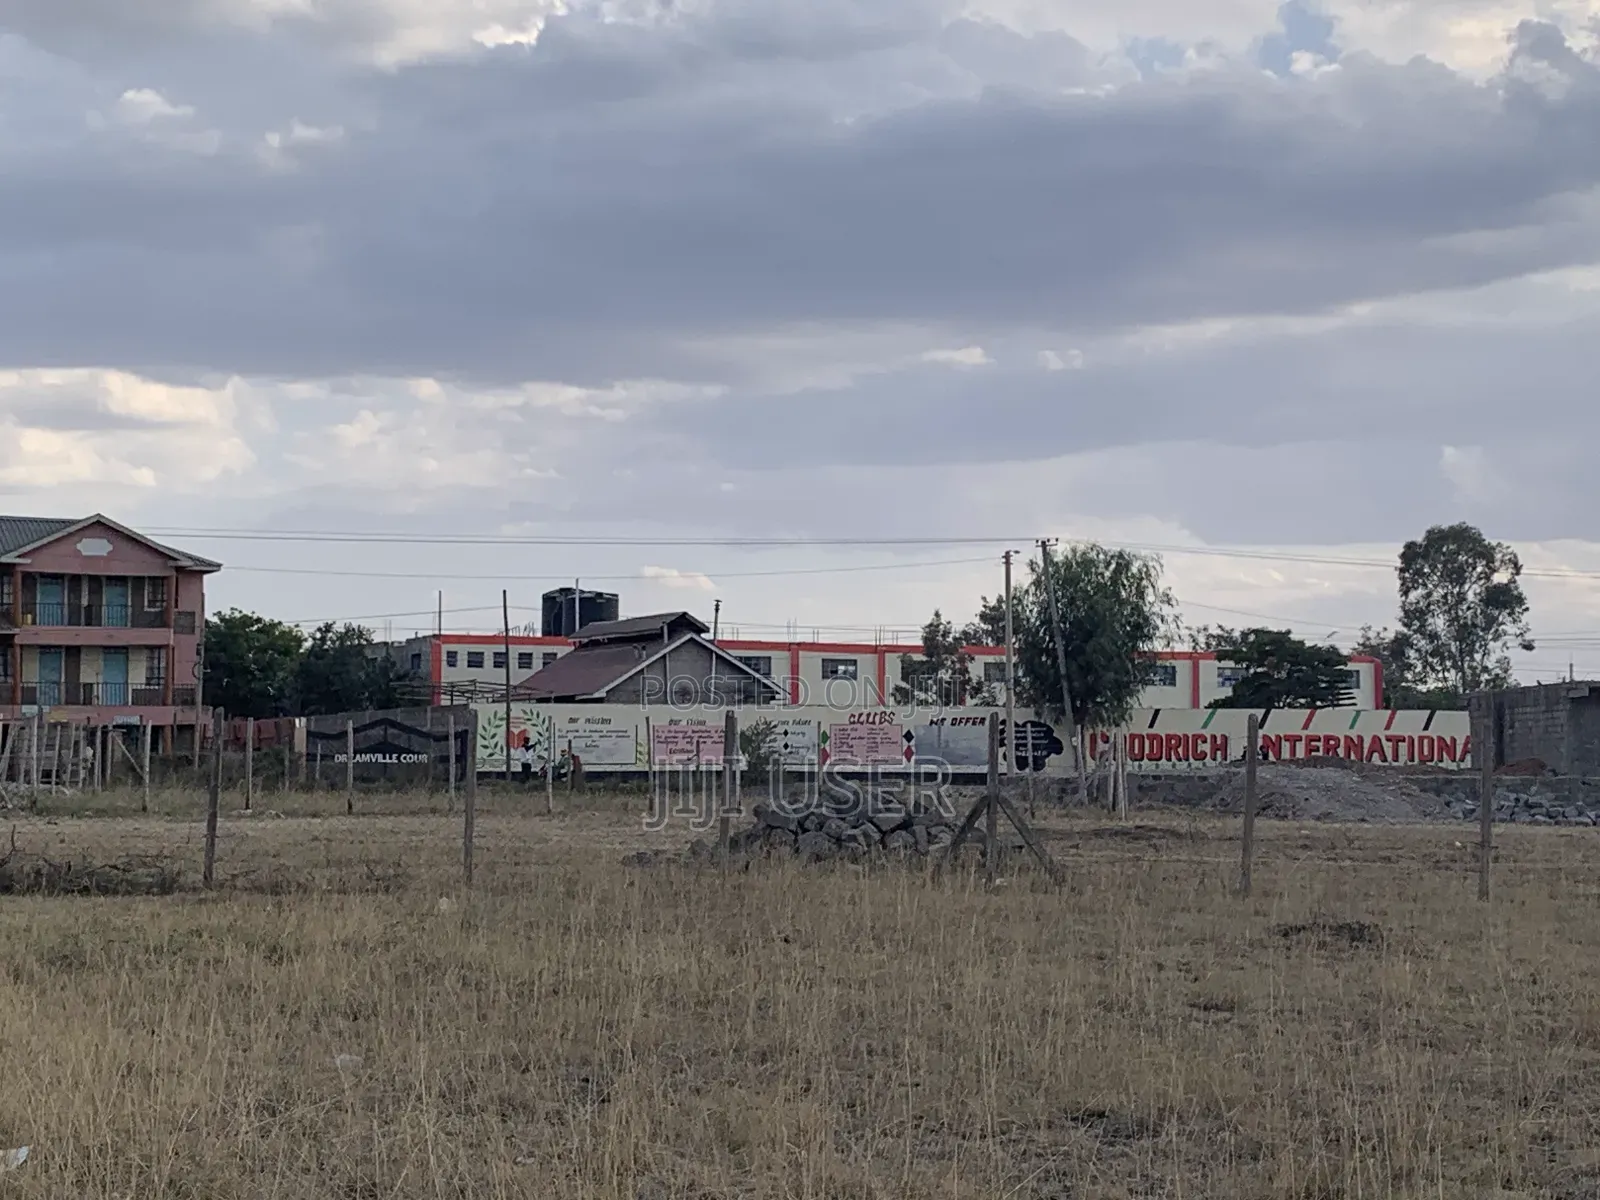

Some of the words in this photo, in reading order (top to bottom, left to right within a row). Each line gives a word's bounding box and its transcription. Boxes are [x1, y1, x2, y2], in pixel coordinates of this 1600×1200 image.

[848, 711, 896, 726] CLUBS
[950, 716, 987, 727] OFFER
[1089, 731, 1229, 763] GODRICH
[1250, 733, 1472, 763] NTERNATIONA
